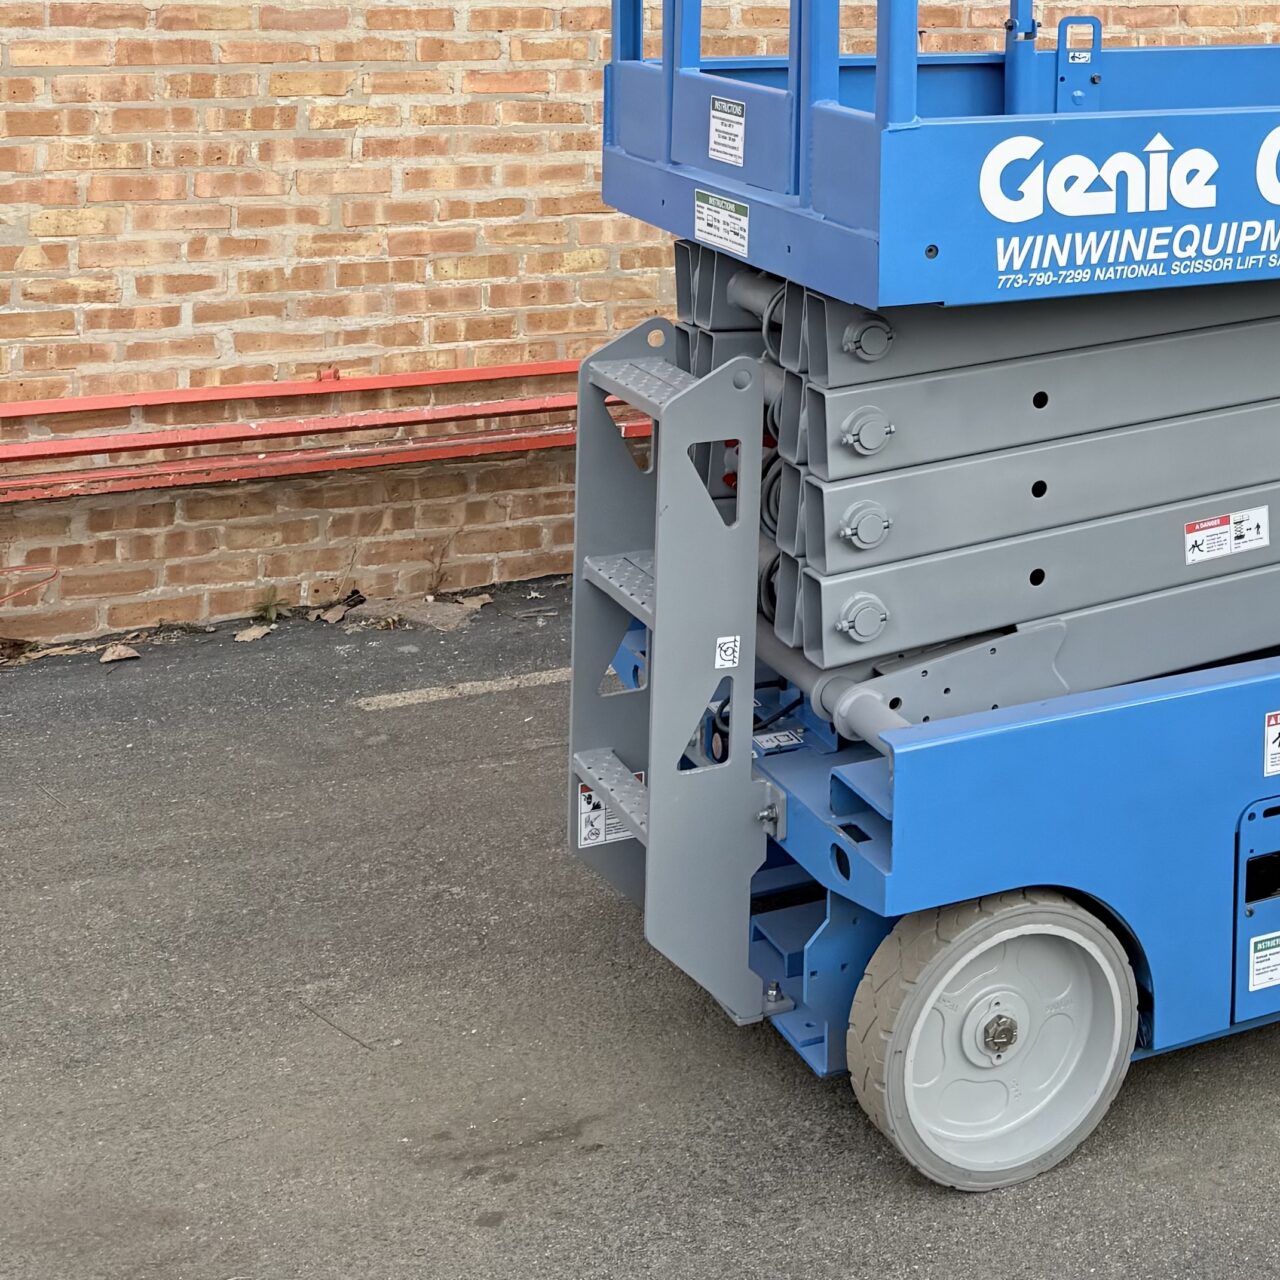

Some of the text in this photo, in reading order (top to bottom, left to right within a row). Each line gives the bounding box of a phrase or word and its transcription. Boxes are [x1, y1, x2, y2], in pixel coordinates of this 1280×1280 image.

[979, 132, 1219, 223] Genie
[997, 268, 1091, 289] 773-790-7299
[1094, 262, 1166, 281] NATIONAL
[1171, 257, 1233, 275] SCISSOR
[1236, 254, 1266, 269] LIFT
